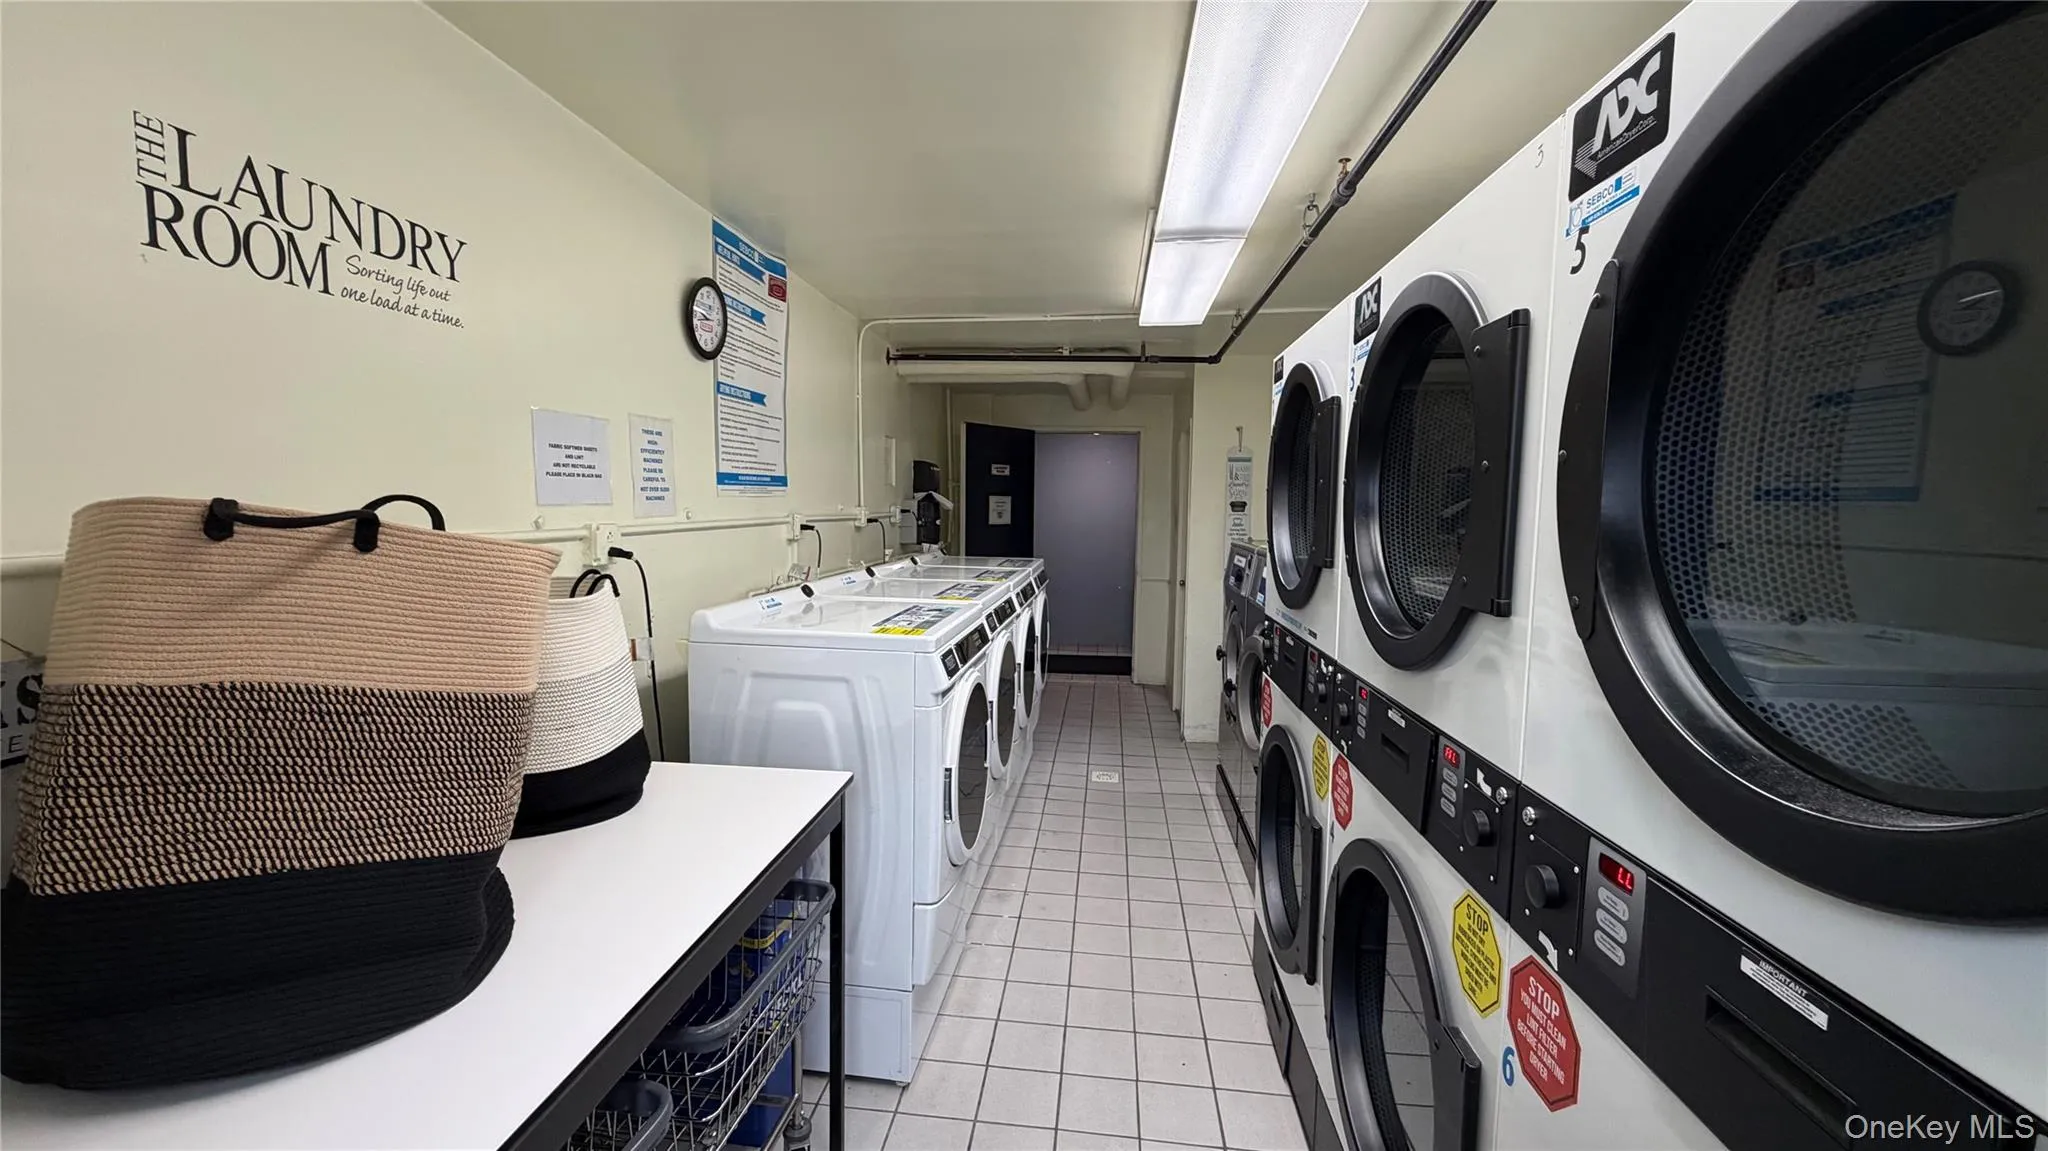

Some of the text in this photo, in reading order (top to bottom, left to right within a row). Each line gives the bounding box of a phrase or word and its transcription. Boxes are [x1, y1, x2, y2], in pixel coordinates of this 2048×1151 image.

[1592, 51, 1661, 153] ADC
[132, 110, 167, 180] THE
[167, 122, 467, 283] LAUNDRY
[1587, 184, 1614, 208] SEBCO
[136, 180, 335, 297] ROOM
[1570, 225, 1590, 275] 5
[345, 254, 451, 301] Sorting life out
[341, 287, 464, 329] one load at a time.
[1466, 902, 1489, 936] STOP
[1528, 976, 1560, 1019] STOP
[1759, 960, 1808, 997] IMPORTANT
[1520, 988, 1567, 1051] YOU MUST CLEAN
[1526, 1013, 1559, 1059] LINT FILTER
[1502, 1046, 1515, 1087] 6
[1517, 1018, 1565, 1085] BEFORE STARTING
[1529, 1051, 1549, 1082] DRYER
